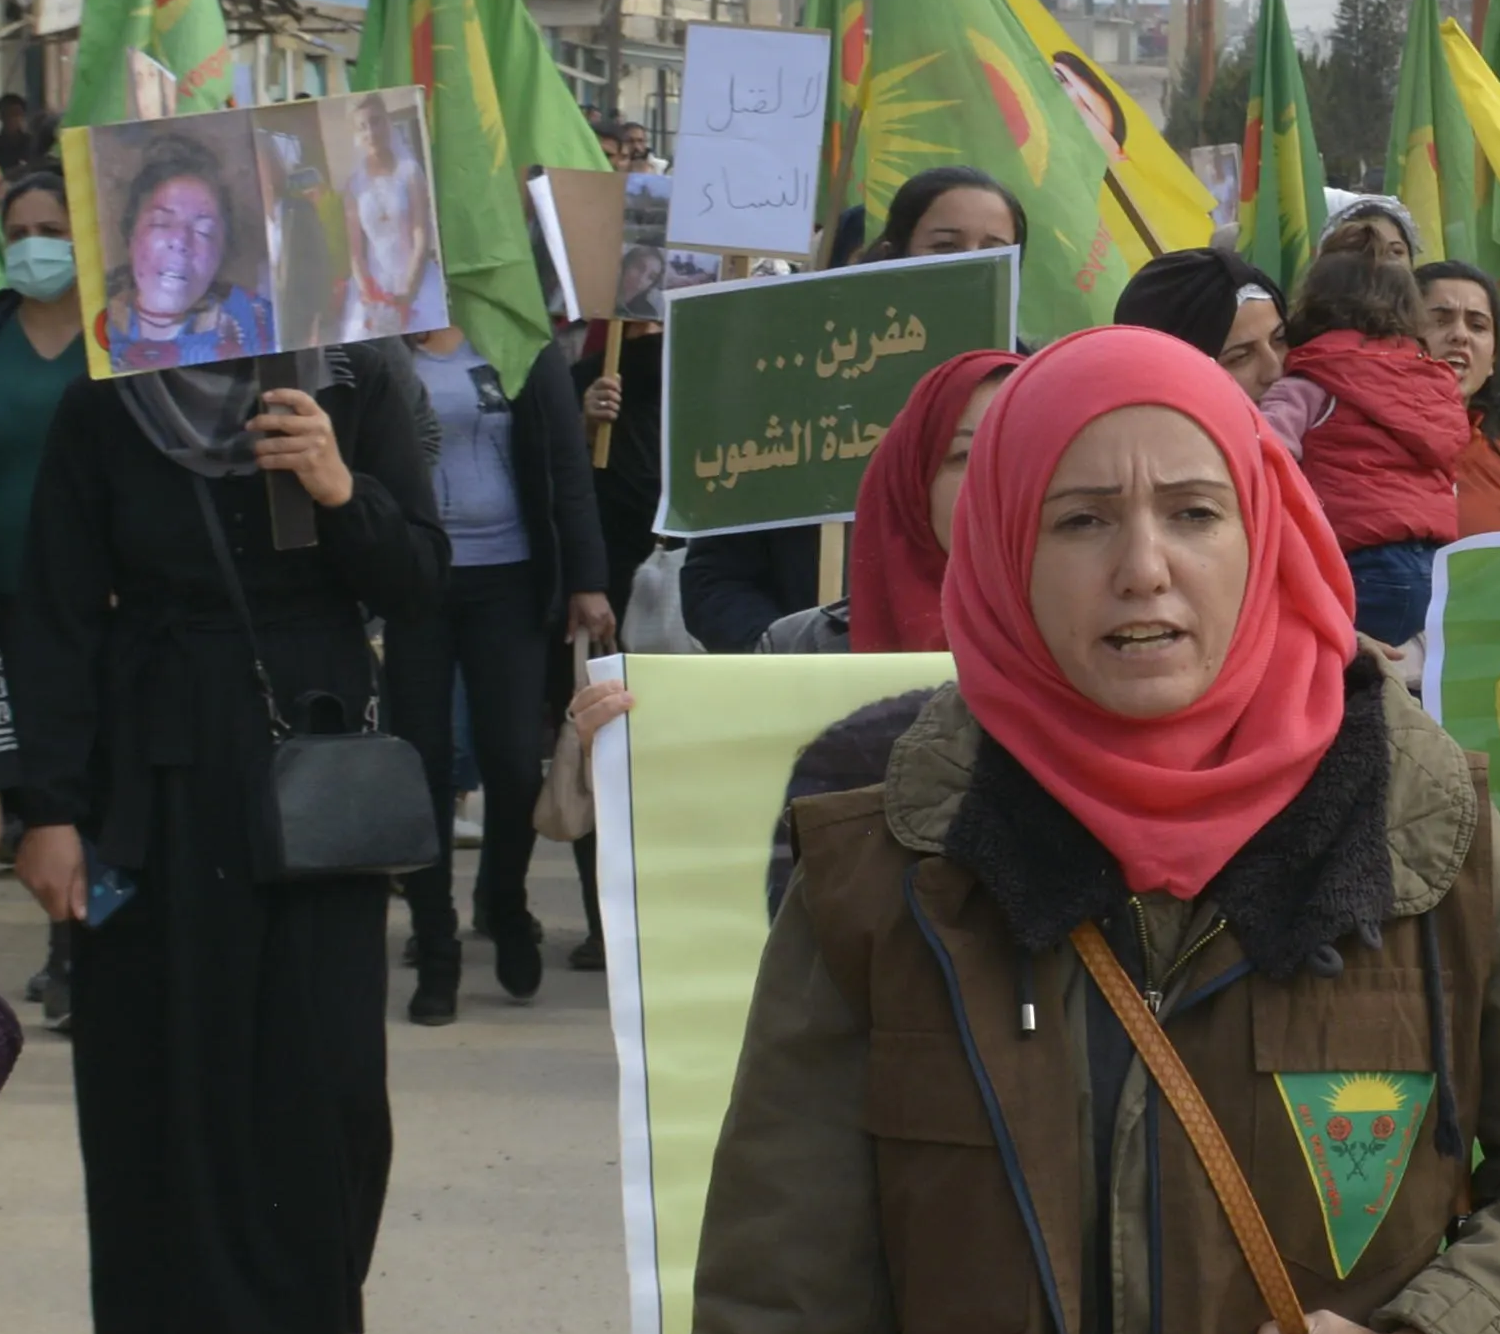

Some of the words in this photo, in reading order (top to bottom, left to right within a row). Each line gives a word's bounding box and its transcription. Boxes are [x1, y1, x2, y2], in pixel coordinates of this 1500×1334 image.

[793, 70, 823, 119] لا
[698, 166, 809, 217] النساء
[815, 306, 928, 379] هفرين
[694, 414, 813, 493] الشعوب
[820, 415, 891, 462] حدة
